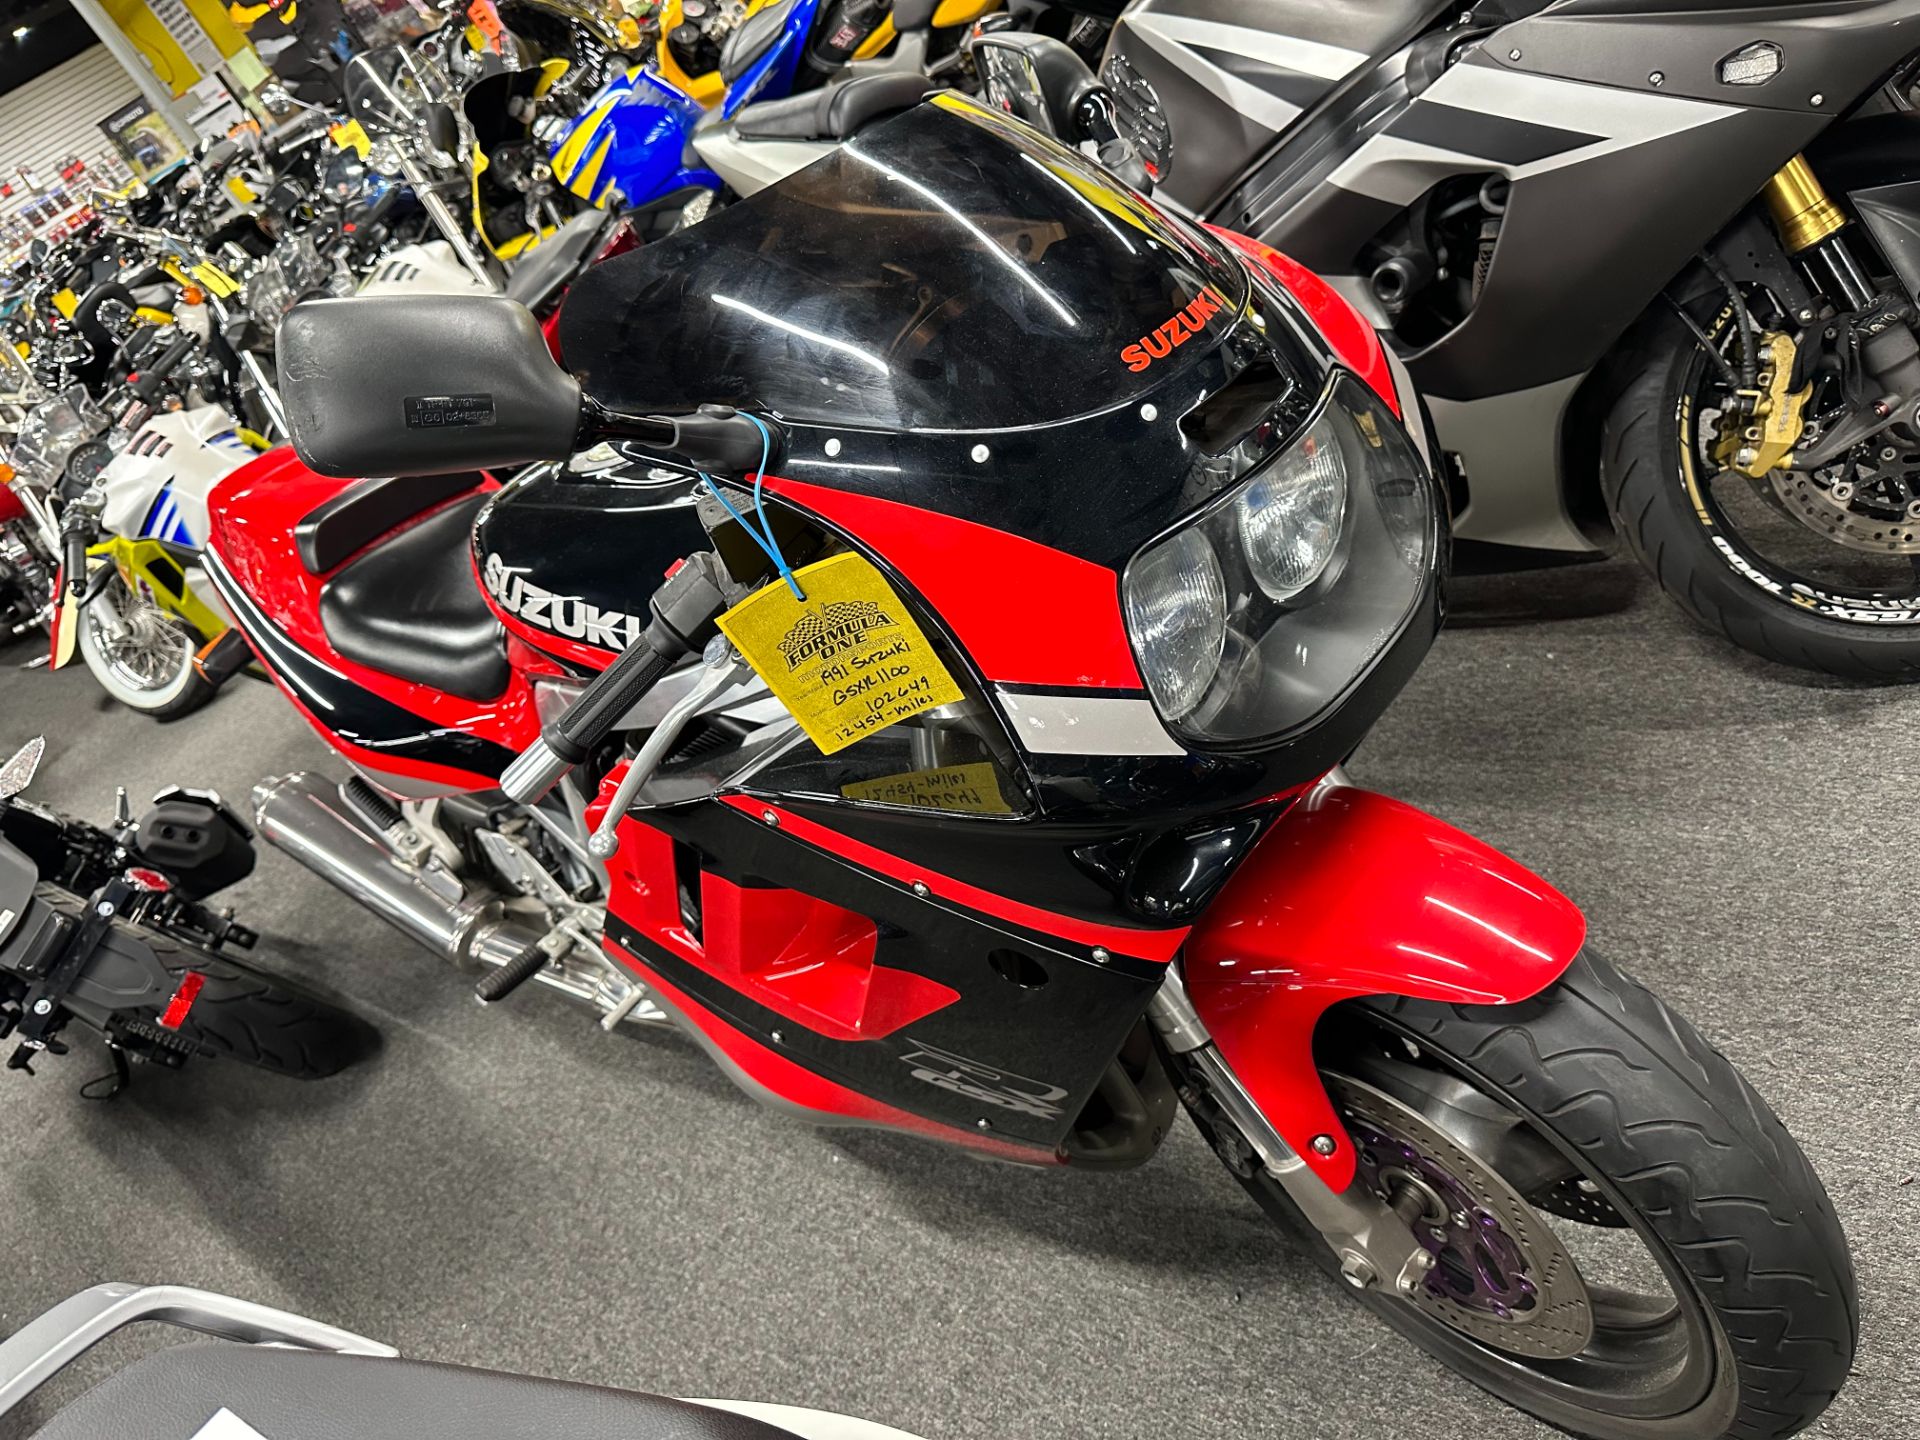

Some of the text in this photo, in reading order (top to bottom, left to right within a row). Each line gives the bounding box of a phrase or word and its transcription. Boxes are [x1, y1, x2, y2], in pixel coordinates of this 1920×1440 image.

[1120, 286, 1224, 373] SUZUKI
[484, 552, 641, 651] SUZUKI
[788, 612, 896, 670] FORMULA
[818, 631, 869, 661] ONE
[821, 638, 912, 687] 1991 Suzuki
[865, 675, 931, 713] 102649
